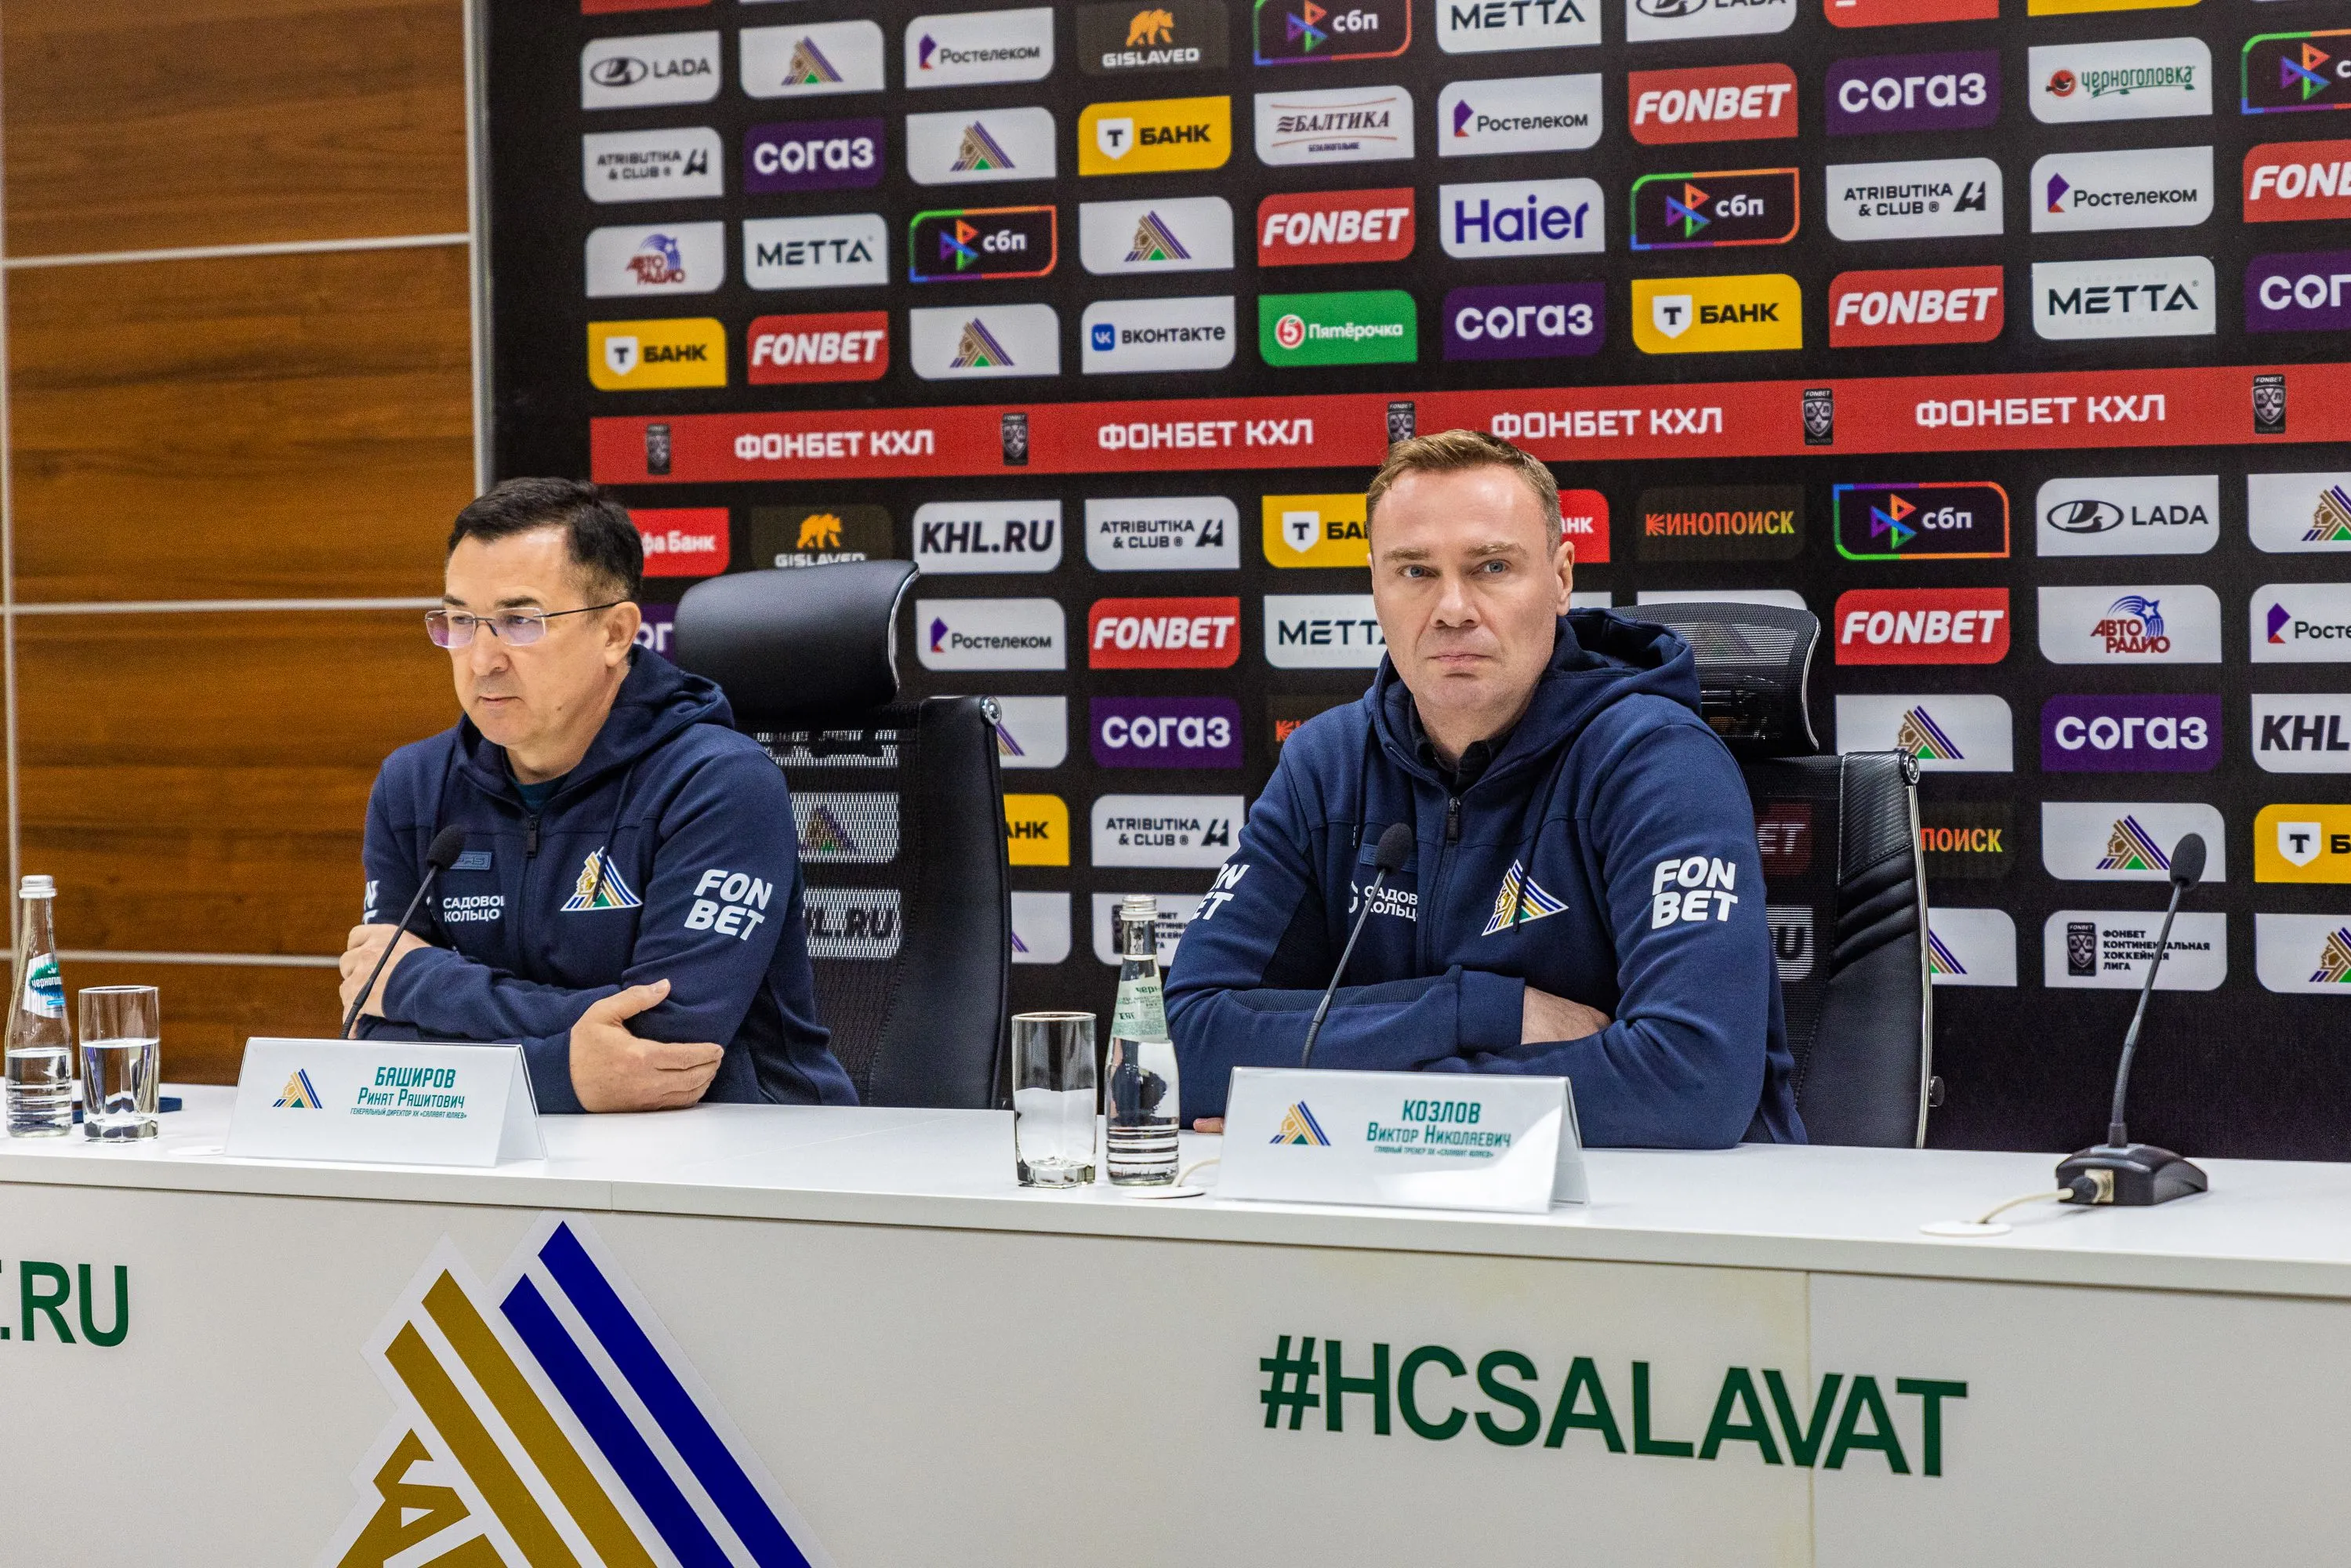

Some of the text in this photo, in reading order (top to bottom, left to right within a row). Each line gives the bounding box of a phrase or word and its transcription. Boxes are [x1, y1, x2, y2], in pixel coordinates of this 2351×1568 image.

[1451, 0, 1586, 31] METTA
[941, 45, 1040, 66] Ростелеком
[1102, 48, 1199, 67] GISLAVED
[653, 57, 711, 79] LADA
[1634, 84, 1790, 125] FONBET
[1294, 111, 1390, 132] БАЛТИКА
[1478, 112, 1588, 132] Ростелеком
[1140, 124, 1211, 145] БАНК
[597, 150, 681, 167] ATRIBUTIKA
[622, 165, 660, 180] CLUB
[1844, 183, 1954, 202] ATRIBUTIKA
[2073, 188, 2197, 208] Ростелеком
[1455, 194, 1589, 244] Haier
[1859, 203, 1871, 216] &
[1876, 201, 1925, 216] CLUB
[1262, 209, 1409, 247] FONBET
[756, 238, 873, 267] METTA
[1835, 287, 1997, 326] FONBET
[2048, 282, 2199, 317] METTA
[1700, 303, 1780, 325] БАНК
[1309, 323, 1403, 341] Пятёрочка
[643, 343, 708, 363] БАНК
[752, 329, 883, 366] FONBET
[1916, 394, 2167, 428] ФОНБЕТ КХЛ
[1491, 407, 1723, 439] ФОНБЕТ КХЛ
[735, 429, 934, 459] ФОНБЕТ КХЛ
[1098, 419, 1313, 450] ФОНБЕТ КХЛ
[1100, 520, 1195, 533] ATRIBUTIKA
[1645, 510, 1795, 535] КИНОПОИСК
[2132, 505, 2208, 526] LADA
[667, 529, 717, 554] Банк
[920, 520, 1055, 554] KHL.RU
[1326, 521, 1368, 540] БА
[1113, 536, 1123, 548] &
[1127, 536, 1169, 548] CLUB
[1094, 616, 1235, 650] FONBET
[1279, 619, 1388, 644] METT
[1841, 610, 2005, 644] FONBET
[2090, 619, 2142, 637] АВТО
[952, 633, 1052, 650] Ростелеком
[2106, 636, 2171, 653] РАДИО
[1106, 818, 1200, 831] ATRIBUTIKA
[1119, 834, 1129, 845] &
[1134, 833, 1174, 846] CLUB
[1921, 828, 2003, 852] ПОИСК
[1653, 855, 1736, 895] FON
[694, 869, 774, 911] FON
[1364, 885, 1418, 906] САДОВ
[444, 909, 501, 922] КОЛЬЦО
[1191, 891, 1235, 920] ET
[1365, 900, 1418, 921] ОЛЬЦ
[1651, 890, 1738, 930] BET
[684, 901, 765, 941] BET
[2103, 951, 2169, 960] ХОККЕЙНЯ
[2103, 962, 2131, 971] ЛИГА
[375, 1066, 456, 1089] БАШИРОВ
[1402, 1099, 1481, 1124] КОЗЛОВ
[0, 1261, 129, 1347] .RU
[1259, 1334, 1969, 1477] #HCSALAVAT
